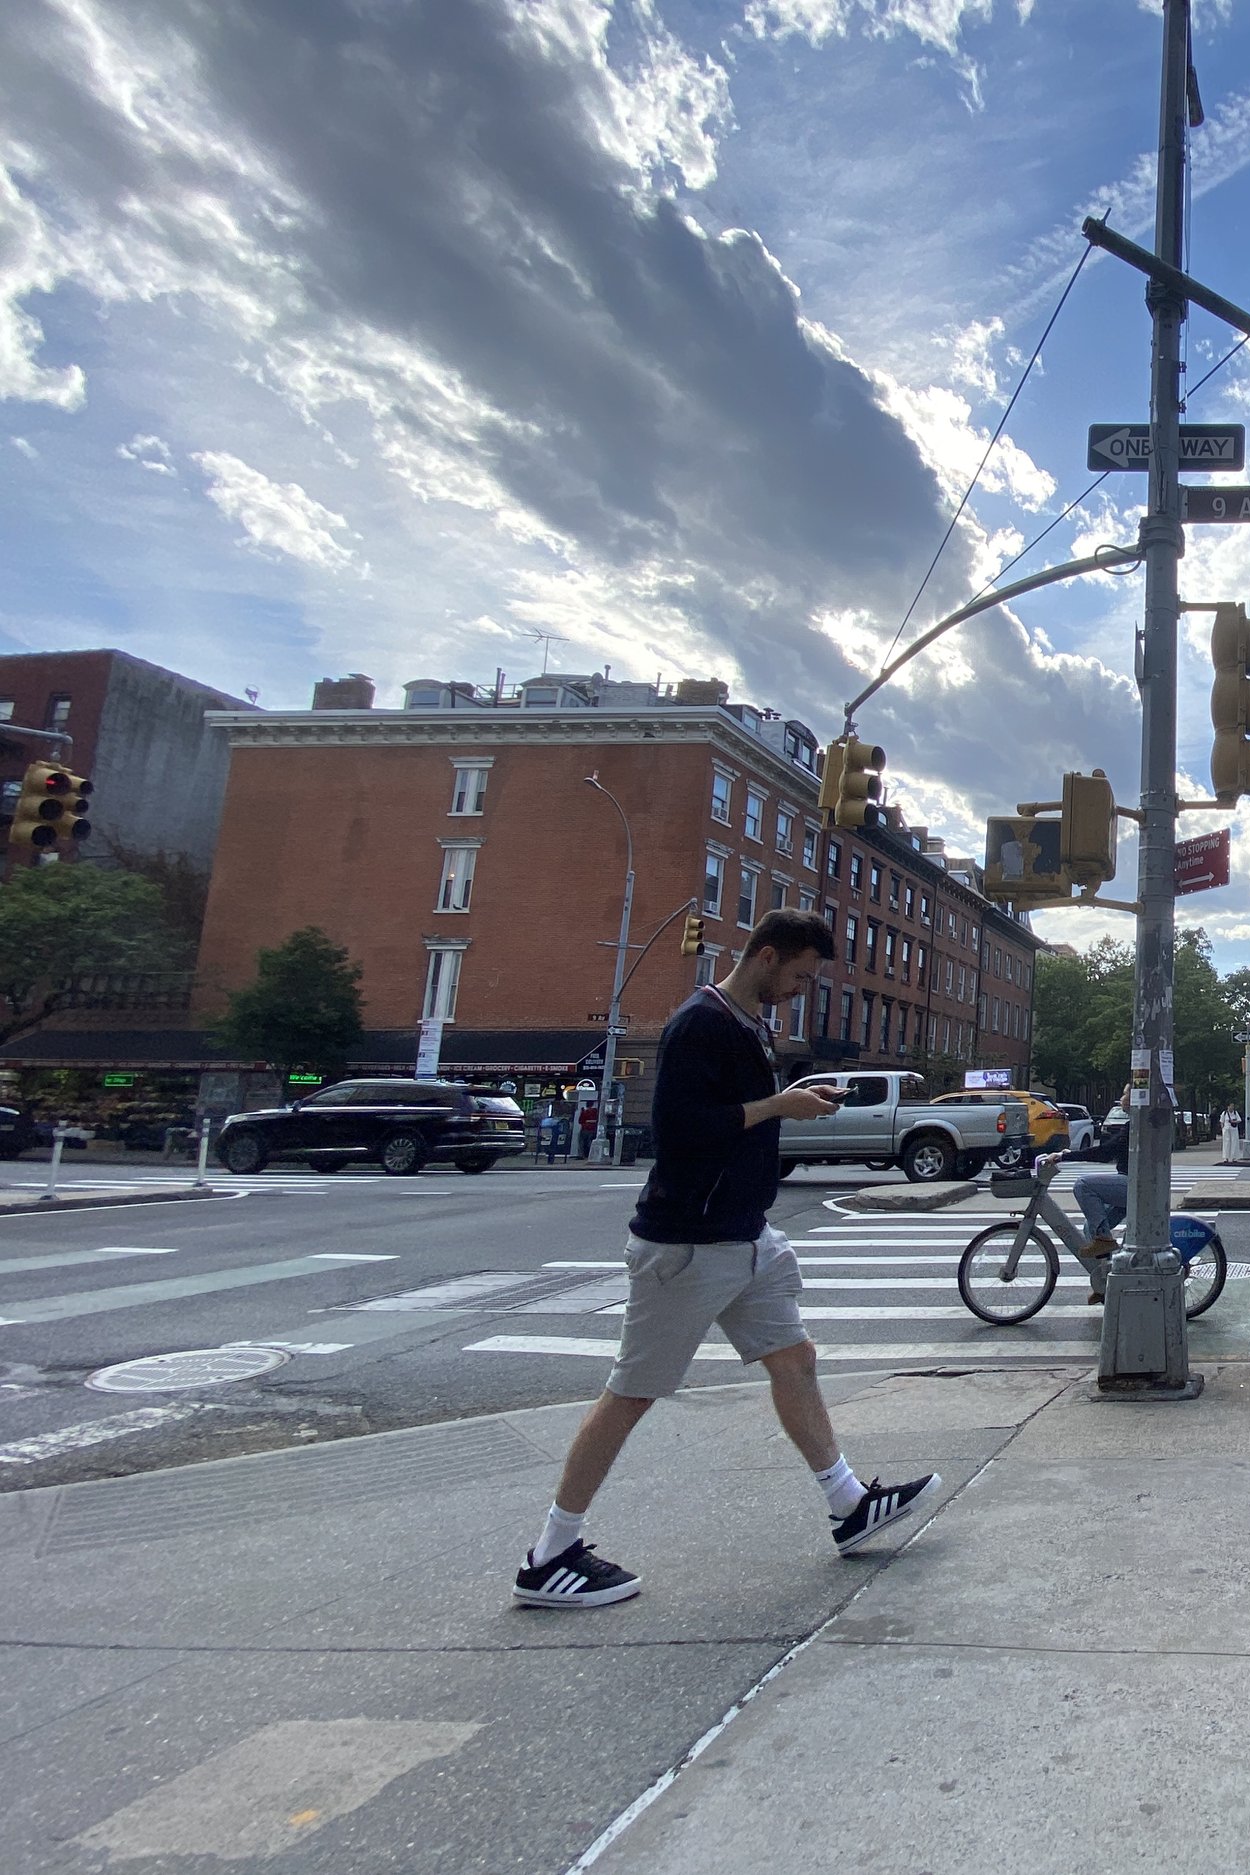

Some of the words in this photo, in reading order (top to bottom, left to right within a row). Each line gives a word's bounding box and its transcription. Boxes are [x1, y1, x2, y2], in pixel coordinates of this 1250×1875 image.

[1109, 438, 1151, 457] ONE
[1181, 438, 1230, 457] WAY
[1211, 496, 1227, 519] 9
[1188, 837, 1220, 855] STOPPING
[1177, 856, 1204, 870] Anytime
[1187, 1229, 1205, 1238] bike
